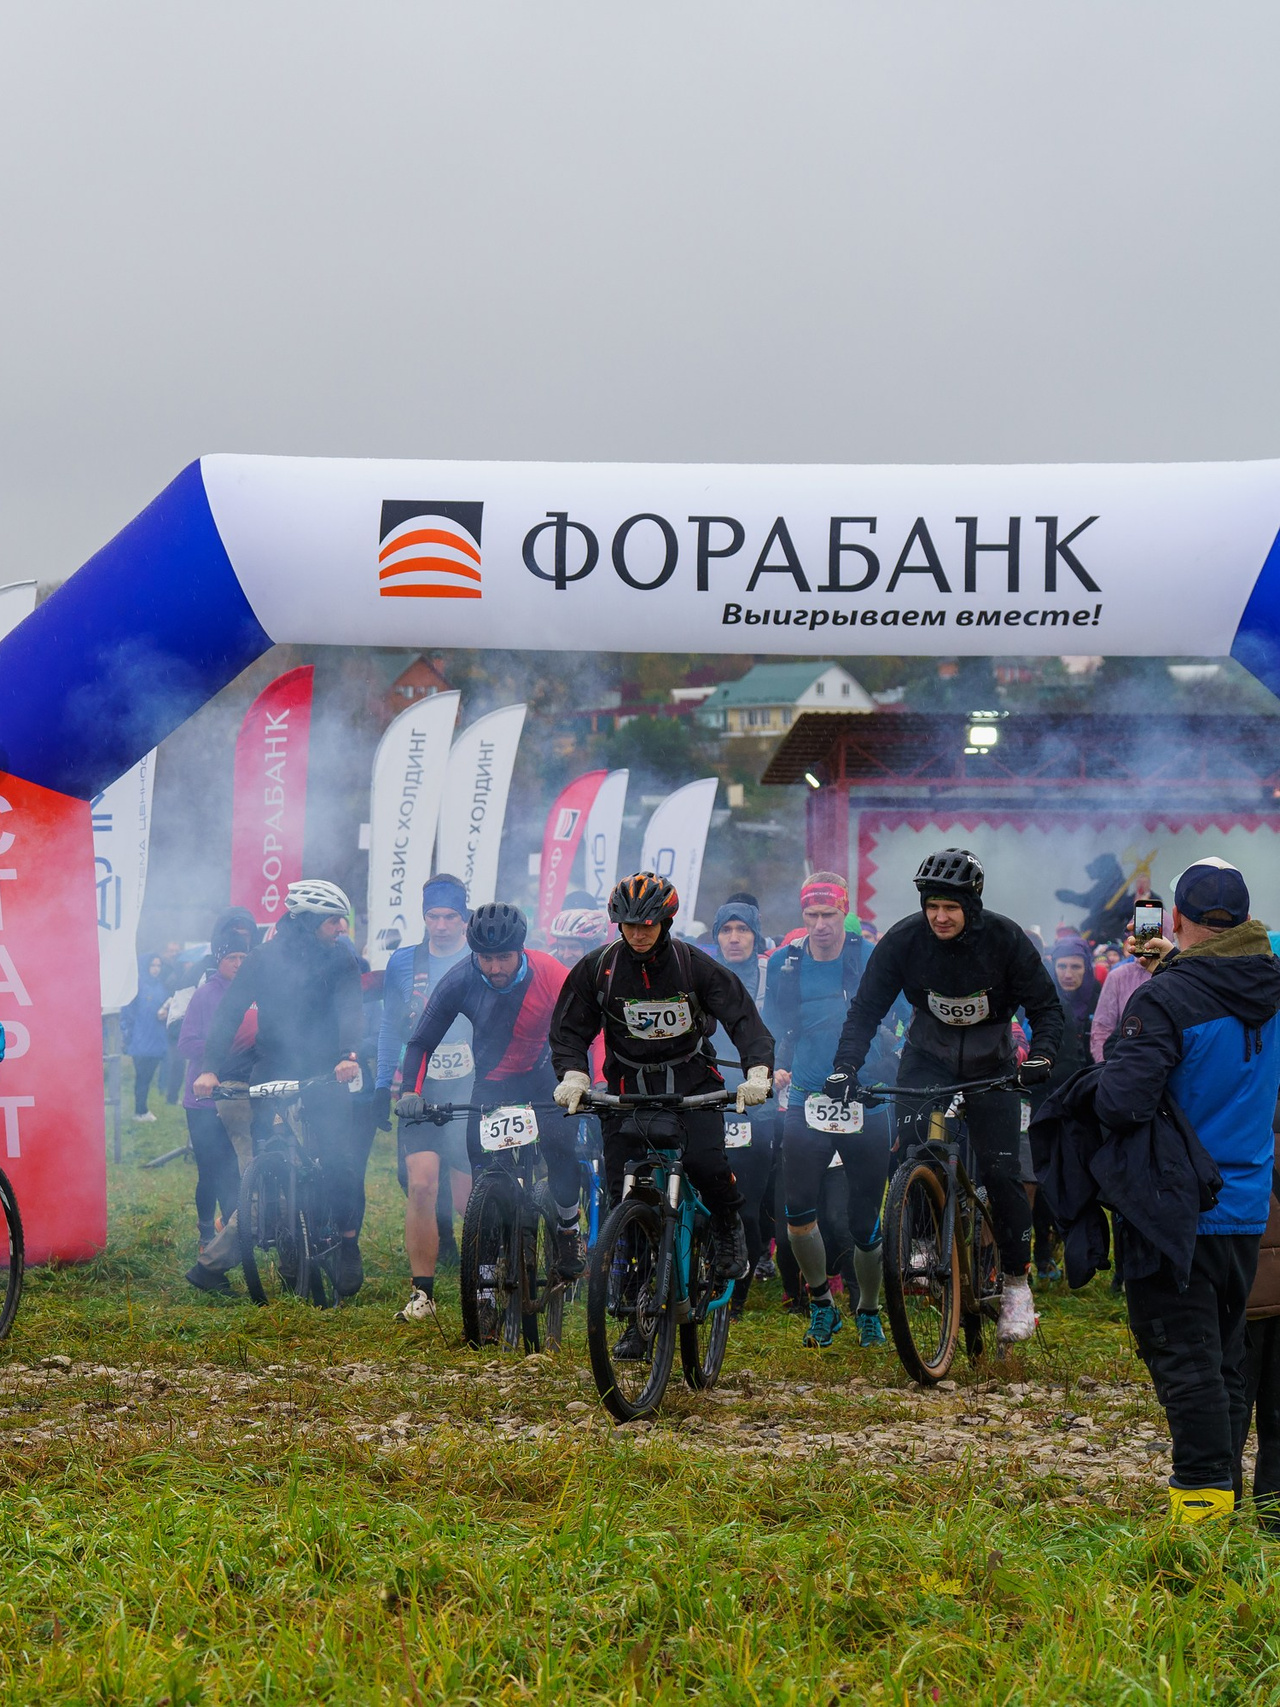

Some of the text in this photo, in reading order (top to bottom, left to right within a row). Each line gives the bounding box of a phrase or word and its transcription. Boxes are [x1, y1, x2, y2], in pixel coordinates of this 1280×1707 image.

[521, 511, 1102, 593] ФОРАБАНК
[721, 602, 1102, 630] Выигрываем вместе!
[469, 739, 495, 835] ХОЛДИНГ
[261, 708, 290, 913] ФОРАБАНК
[389, 728, 426, 906] БАЗИС ХОЛДИНГ
[637, 1010, 677, 1028] 570
[940, 1003, 976, 1018] 569
[431, 1052, 464, 1069] 552
[260, 1082, 288, 1097] 577
[816, 1105, 851, 1121] 525
[489, 1115, 525, 1138] 575
